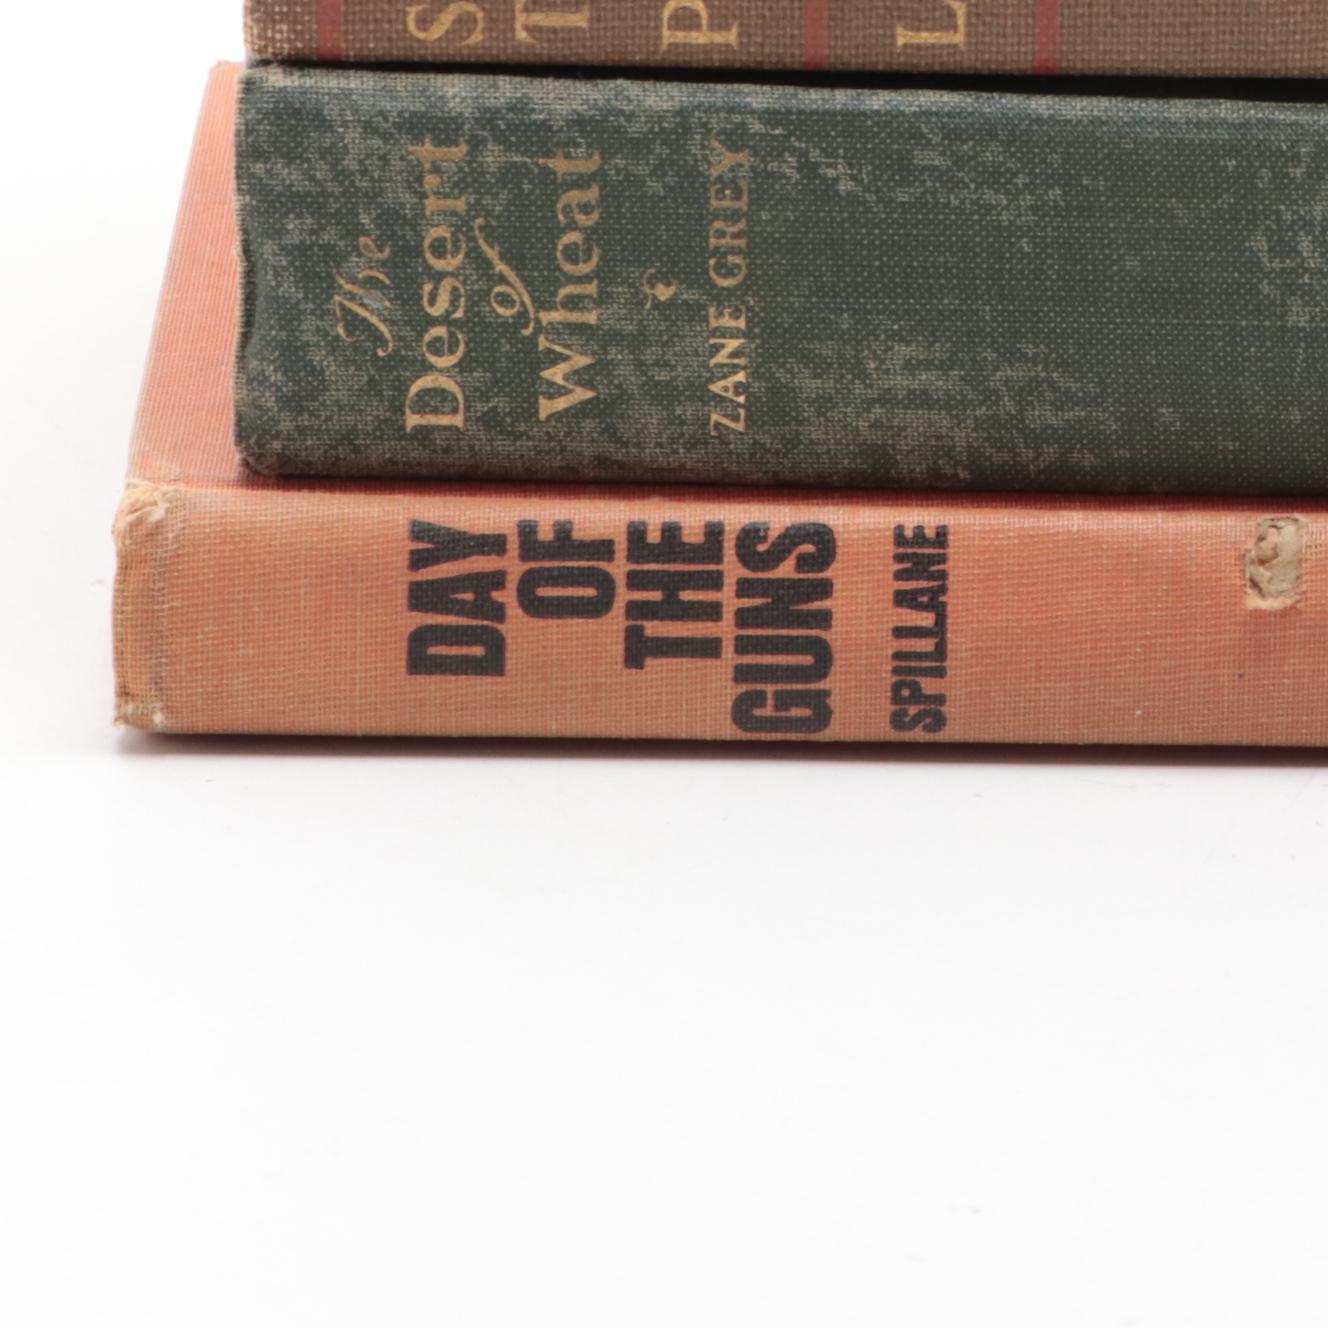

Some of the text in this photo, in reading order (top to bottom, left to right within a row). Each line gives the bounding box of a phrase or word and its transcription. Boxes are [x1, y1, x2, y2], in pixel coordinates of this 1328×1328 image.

[332, 235, 394, 357] The
[405, 134, 470, 433] Desert
[473, 216, 536, 337] of
[537, 150, 602, 422] Wheat
[707, 136, 752, 437] ZANE GREY
[406, 519, 508, 677] DAY
[516, 519, 616, 620] OF
[623, 520, 725, 671] THE
[731, 520, 837, 735] GUNS
[888, 523, 949, 734] SPILLANE
